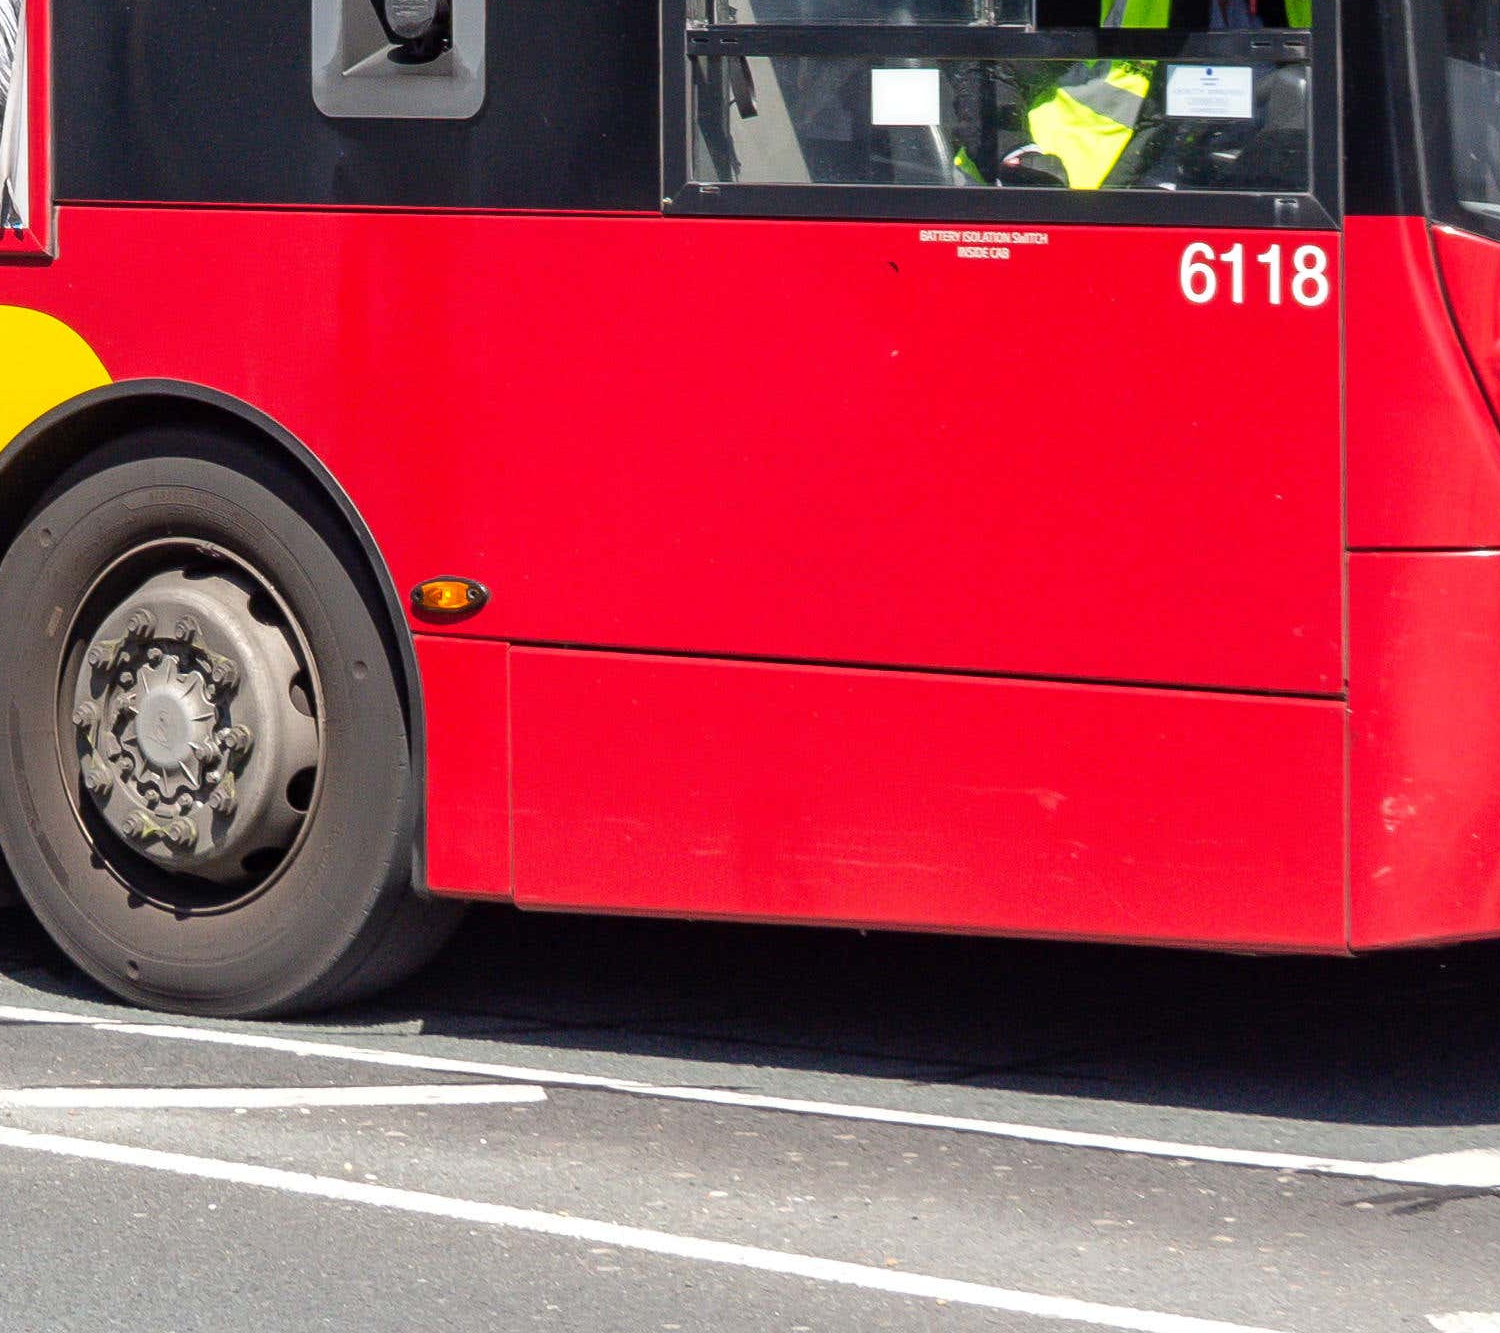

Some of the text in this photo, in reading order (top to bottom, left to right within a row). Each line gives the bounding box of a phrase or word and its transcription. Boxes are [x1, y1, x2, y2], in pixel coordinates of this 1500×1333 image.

[919, 229, 962, 242] BATTERY
[962, 230, 1011, 244] ISOLATION
[957, 246, 989, 259] INSIDE
[1180, 242, 1330, 308] 6118
